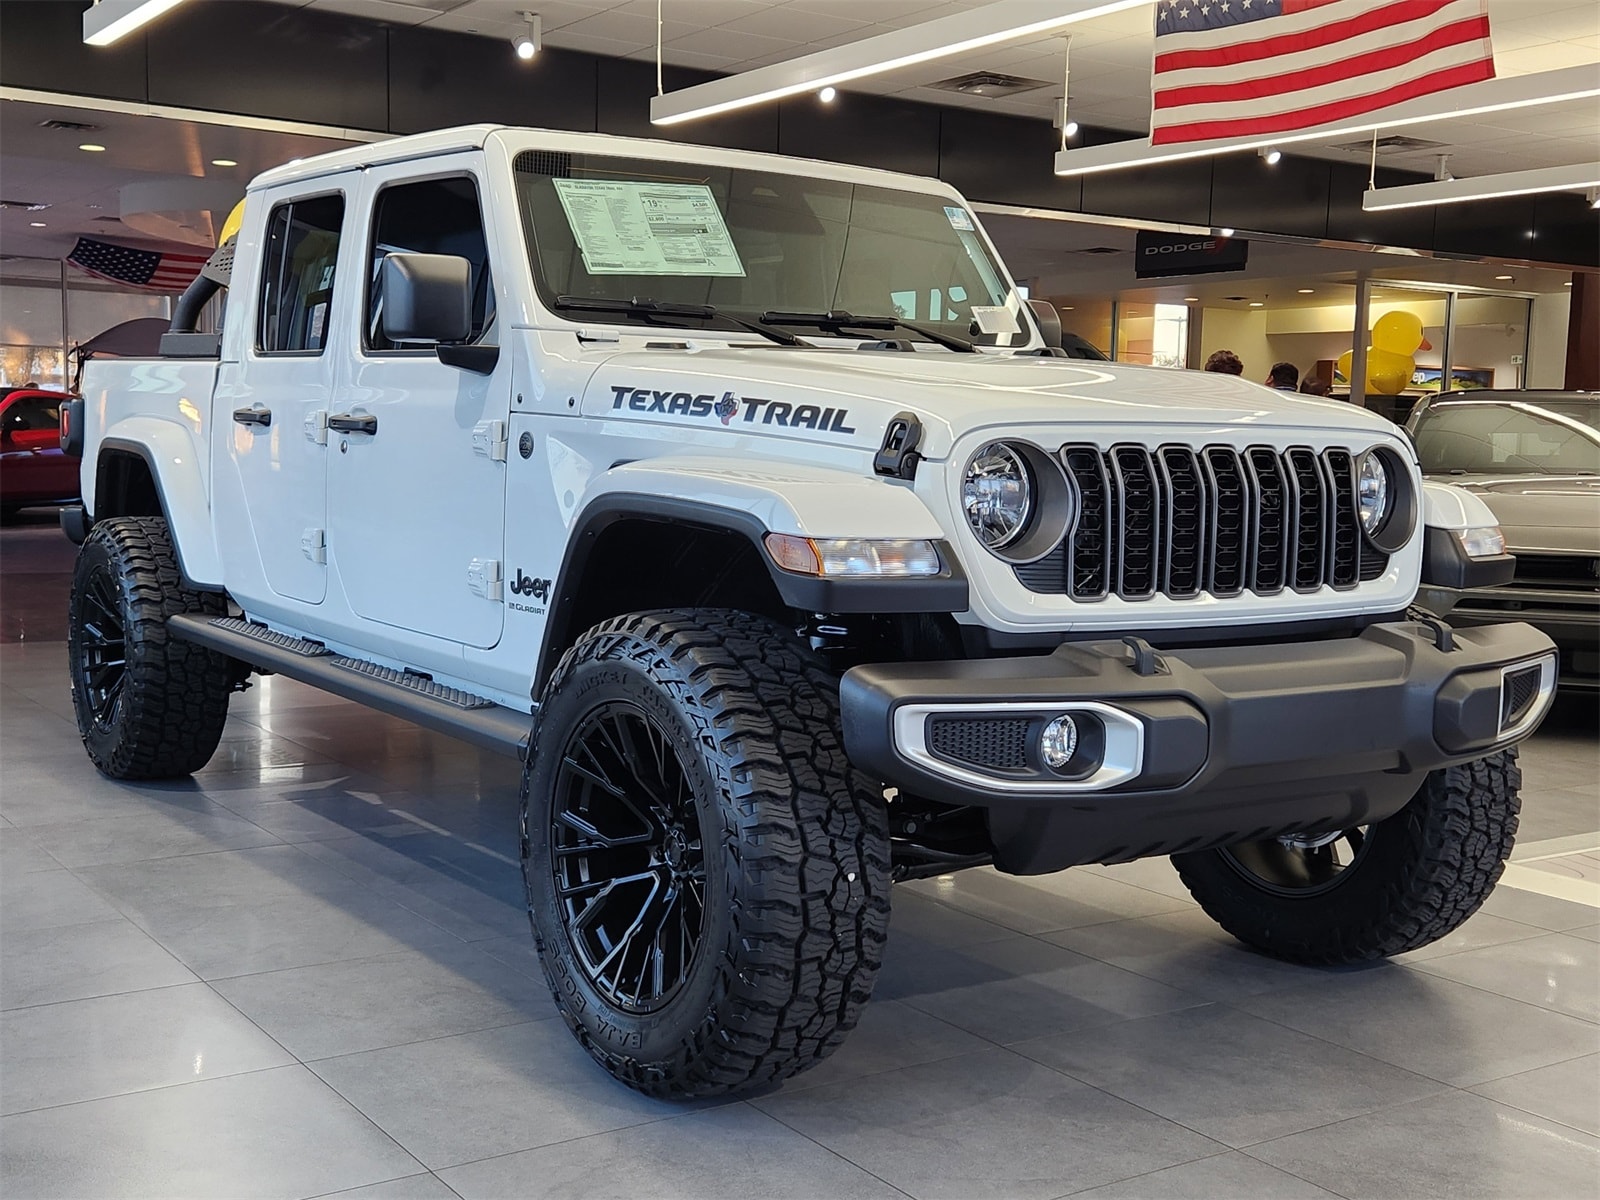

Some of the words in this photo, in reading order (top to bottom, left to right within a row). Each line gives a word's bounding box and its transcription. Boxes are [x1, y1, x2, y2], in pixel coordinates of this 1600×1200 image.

[1145, 241, 1217, 255] DODGE
[1412, 371, 1425, 385] ep
[610, 385, 716, 417] TEXAS
[741, 396, 856, 435] TRAIL
[515, 602, 546, 616] GLADIAT
